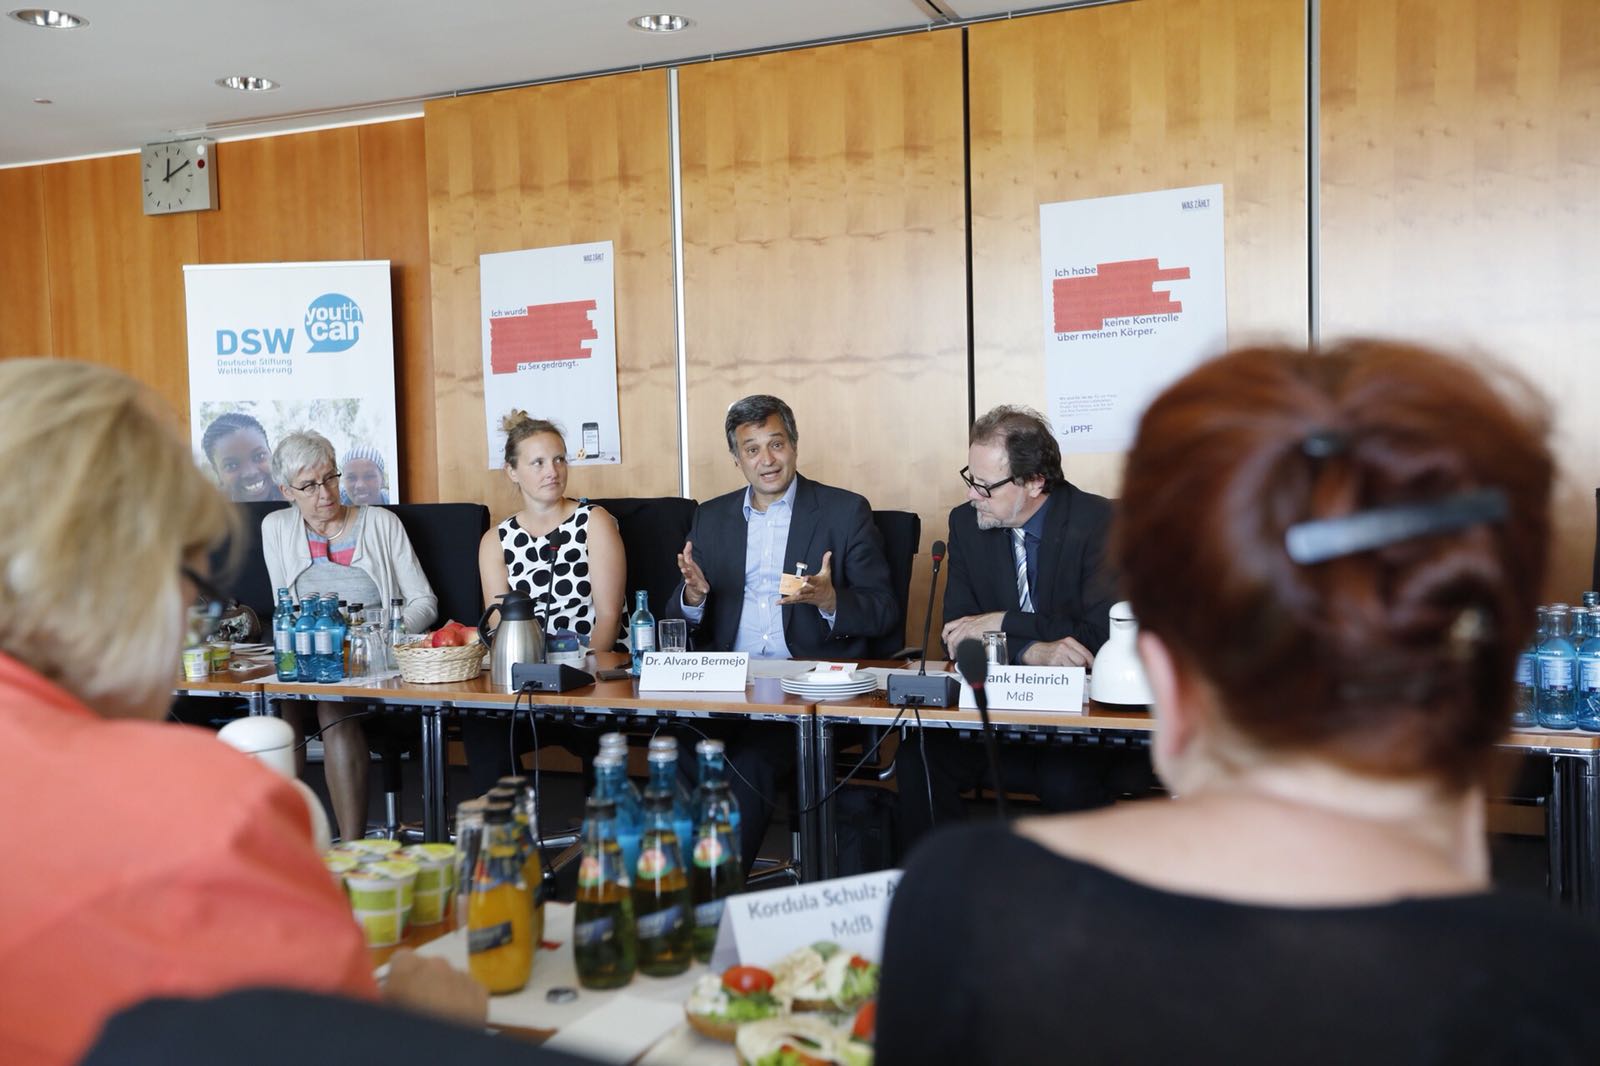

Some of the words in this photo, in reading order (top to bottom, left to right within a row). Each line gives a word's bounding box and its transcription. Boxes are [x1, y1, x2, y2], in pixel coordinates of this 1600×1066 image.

[1054, 268, 1070, 277] Ich
[1071, 266, 1096, 276] habe
[305, 302, 361, 325] youth
[491, 309, 503, 317] Ich
[504, 308, 527, 316] wurde
[1104, 318, 1130, 327] keine
[1132, 314, 1179, 325] Kontrolle
[1057, 333, 1079, 342] über
[1081, 330, 1118, 340] meinen
[1120, 327, 1157, 339] Körper.
[216, 328, 295, 355] DSW
[217, 359, 257, 367] Deutsche
[259, 358, 293, 366] Stiftung
[527, 362, 540, 370] Sex
[217, 366, 293, 375] Weltbevölkerung
[1070, 424, 1094, 433] IPPF
[645, 656, 661, 666] Dr.
[663, 656, 698, 666] Alvaro
[701, 656, 746, 667] Bermejo
[681, 671, 705, 681] IPPF
[987, 673, 1011, 683] ank
[1014, 673, 1069, 685] Heinrich
[1006, 691, 1034, 701] MdB
[747, 893, 819, 919] Kordula
[830, 914, 874, 937] MdB
